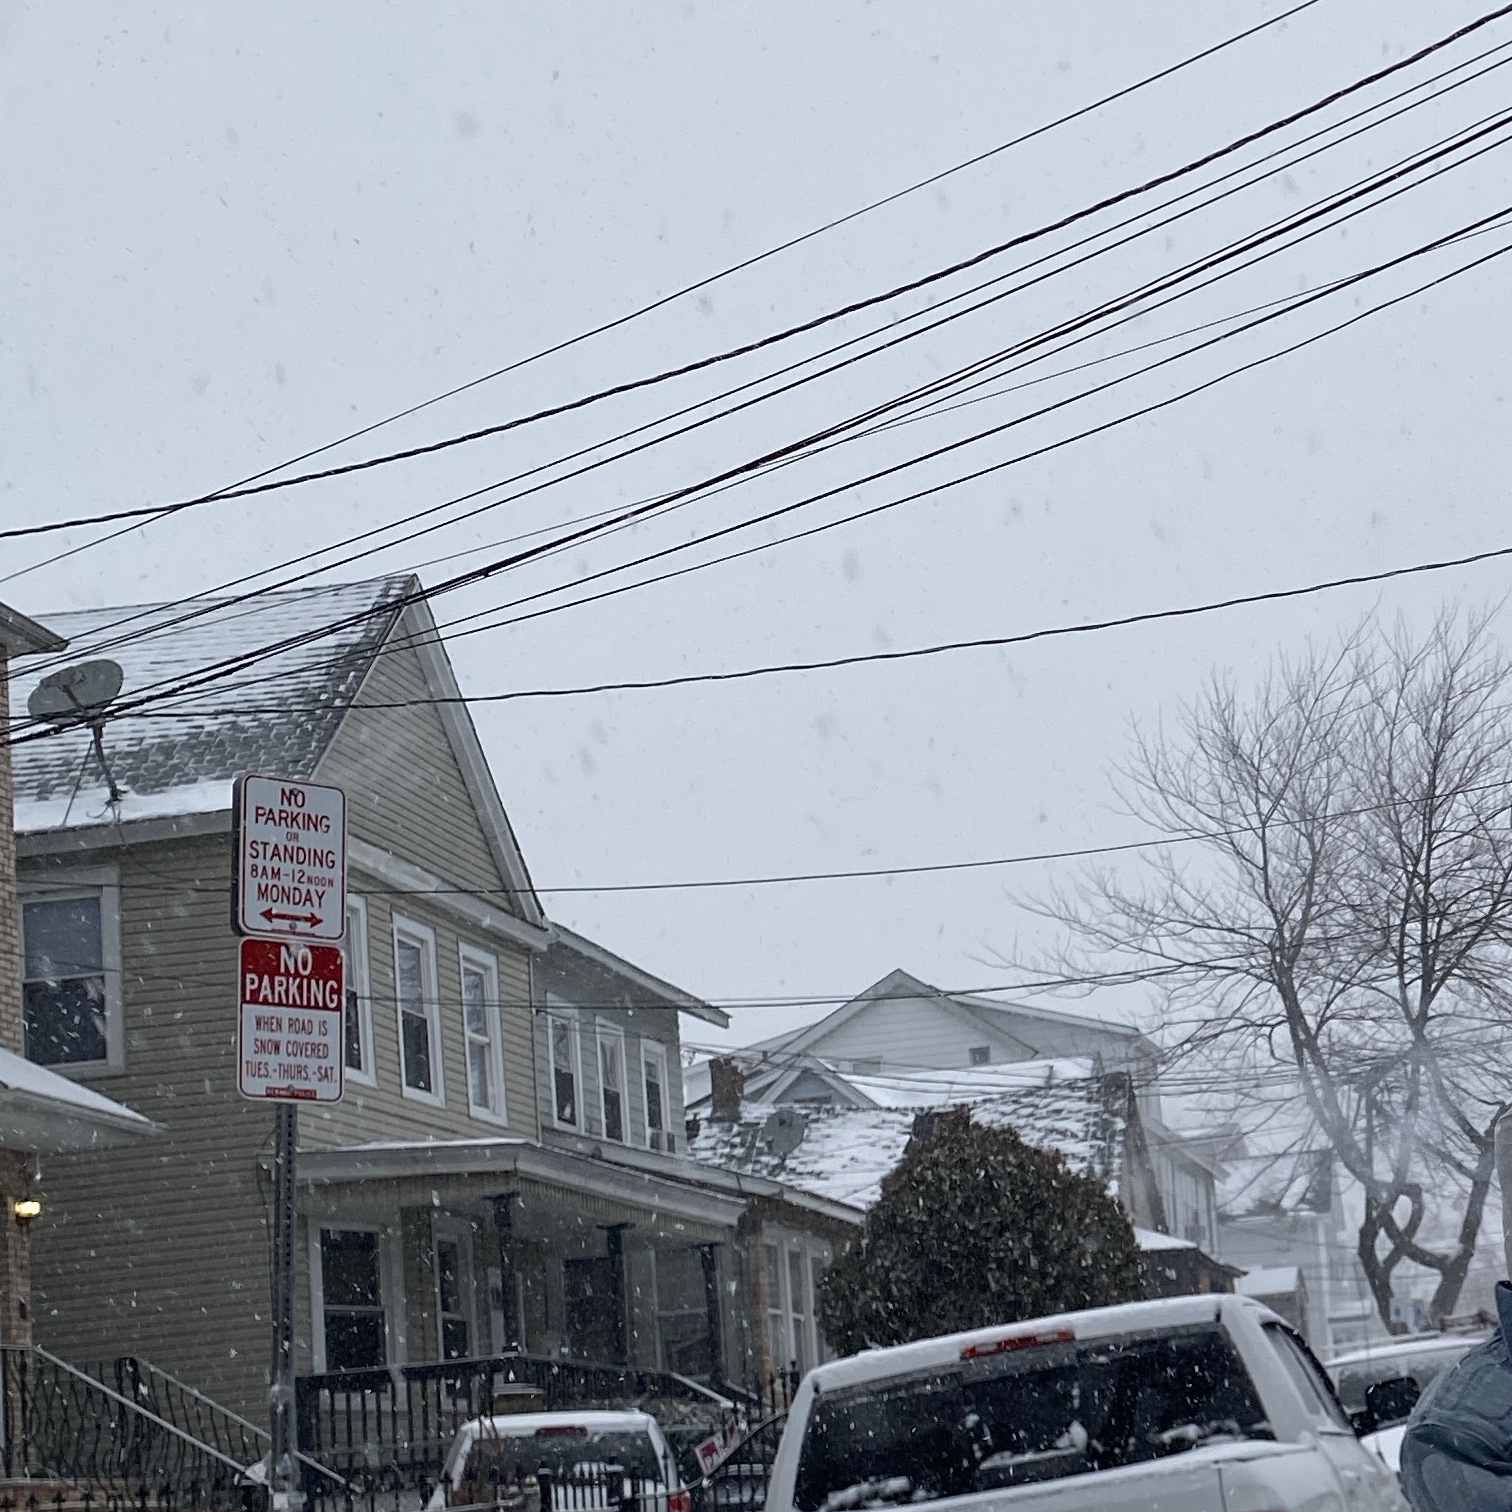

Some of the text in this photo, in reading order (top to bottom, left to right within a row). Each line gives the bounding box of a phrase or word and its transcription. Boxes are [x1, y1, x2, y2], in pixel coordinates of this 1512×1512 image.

[280, 788, 306, 808] NO
[255, 806, 331, 834] PARKING
[286, 831, 299, 842] OR
[249, 840, 335, 869] STANDING
[257, 882, 326, 908] MONDAY
[280, 946, 313, 976] NO
[245, 973, 338, 1008] PARKING
[255, 1015, 328, 1037] WHEN ROAD IS
[253, 1038, 329, 1060] SNOW COVERED
